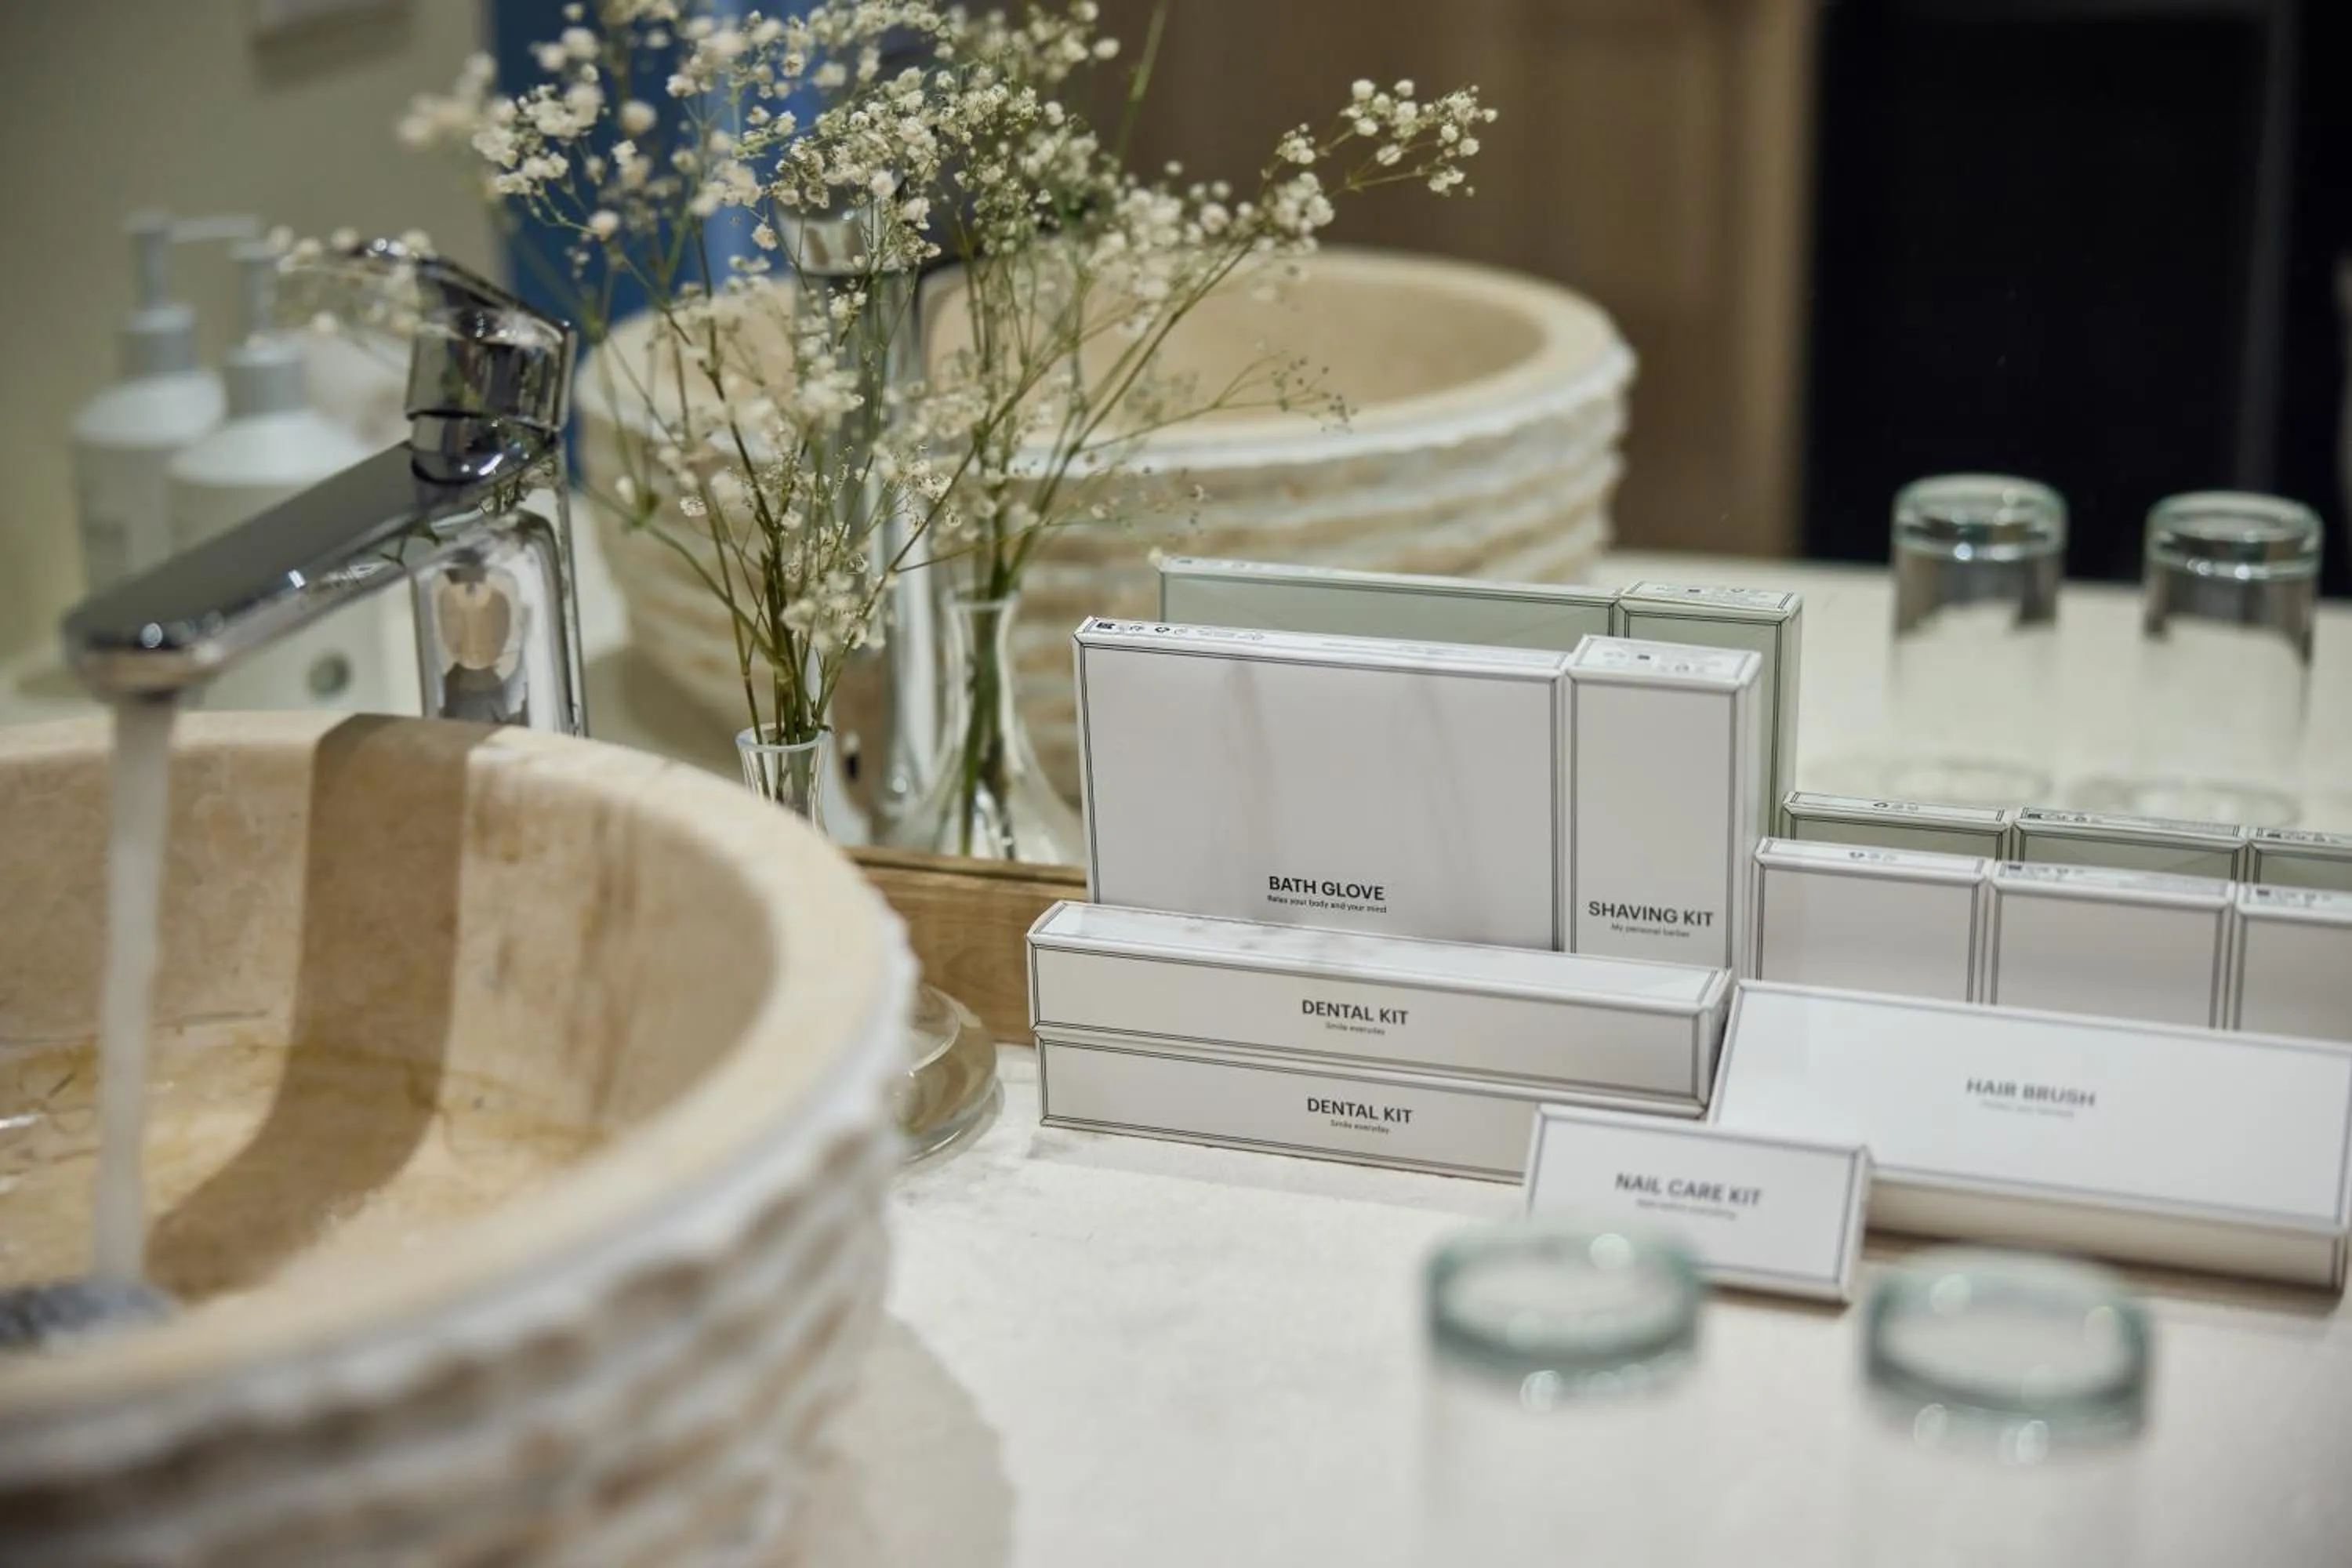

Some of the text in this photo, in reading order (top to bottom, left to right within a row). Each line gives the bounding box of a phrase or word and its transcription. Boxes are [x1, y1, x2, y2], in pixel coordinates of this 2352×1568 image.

[1269, 876, 1385, 901] BATH GLOVE
[1308, 899, 1328, 909] body
[1330, 902, 1346, 910] and
[1367, 905, 1387, 913] mind
[1588, 901, 1714, 927] SHAVING KIT
[1302, 999, 1410, 1025] DENTAL KIT
[1349, 1025, 1386, 1036] everyday
[1965, 1077, 2096, 1107] HAIR BRUSH
[1307, 1097, 1414, 1124] DENTAL KIT
[1354, 1123, 1390, 1134] everyday
[1615, 1172, 1762, 1207] NAIL CARE KIT
